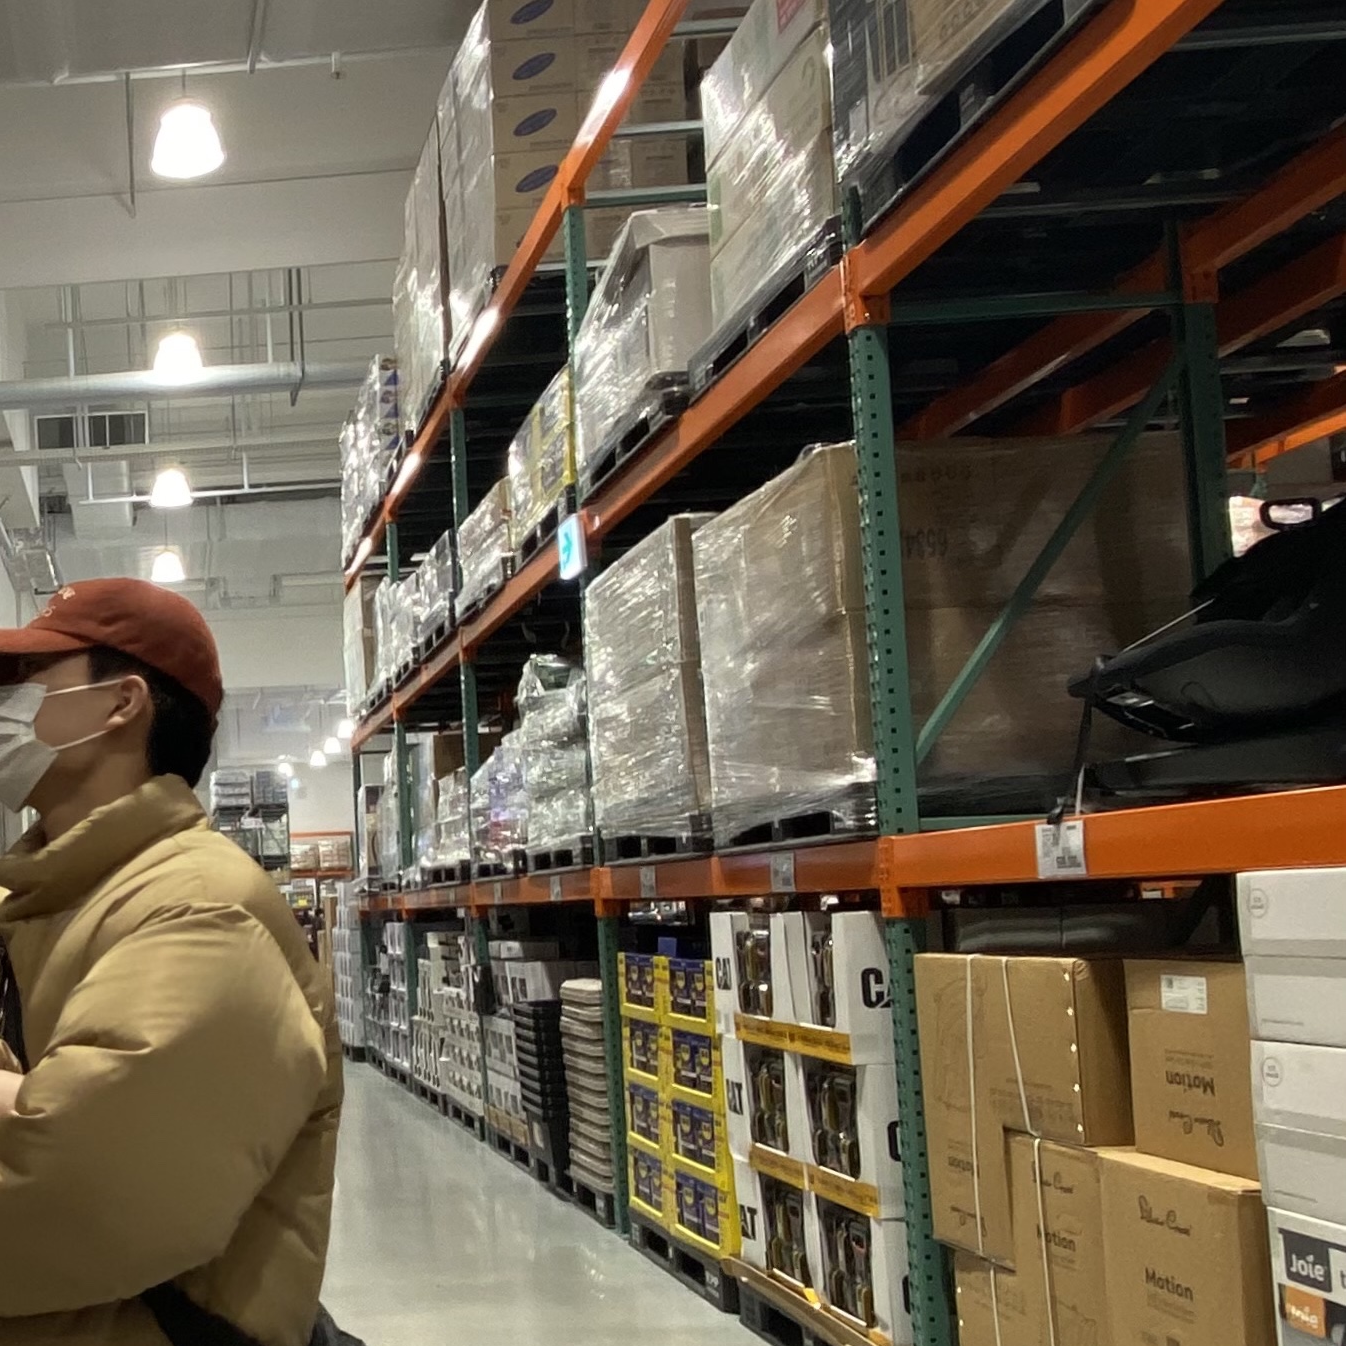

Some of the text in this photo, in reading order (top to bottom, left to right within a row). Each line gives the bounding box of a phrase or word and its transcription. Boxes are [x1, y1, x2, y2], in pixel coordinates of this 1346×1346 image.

[725, 1078, 744, 1116] AT
[1165, 1070, 1216, 1098] Motion
[739, 1203, 758, 1241] AT
[1144, 1266, 1195, 1303] Motion
[1289, 1253, 1325, 1283] Joie
